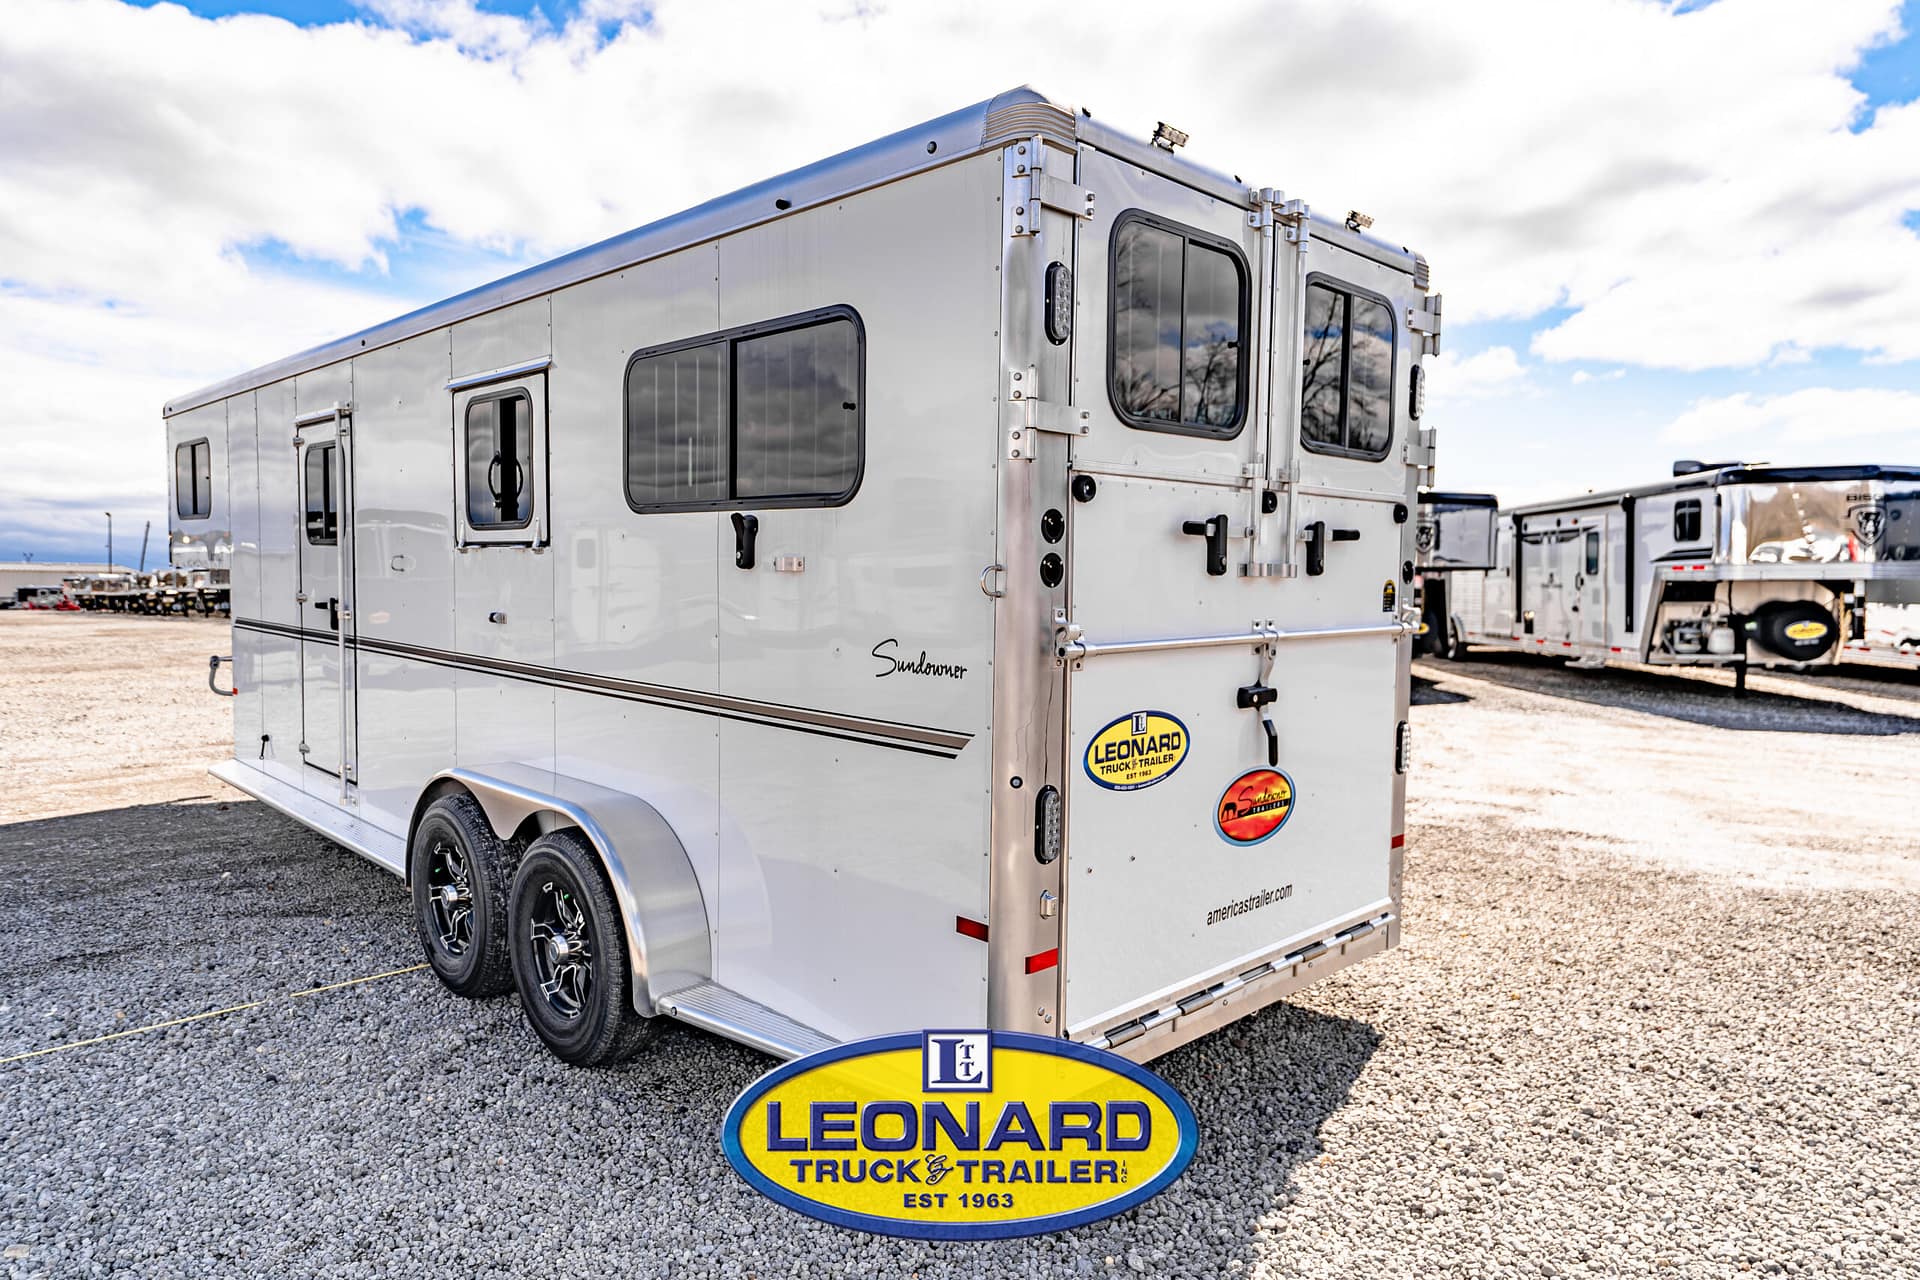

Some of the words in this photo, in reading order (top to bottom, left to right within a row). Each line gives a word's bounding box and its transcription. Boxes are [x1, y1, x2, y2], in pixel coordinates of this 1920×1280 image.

[872, 638, 968, 679] Sundowner
[1094, 731, 1181, 765] LEONARD
[1100, 761, 1131, 776] TRUCK
[1138, 753, 1174, 769] TRAILER
[1126, 772, 1137, 780] EST
[1206, 883, 1293, 926] americastrailer.com
